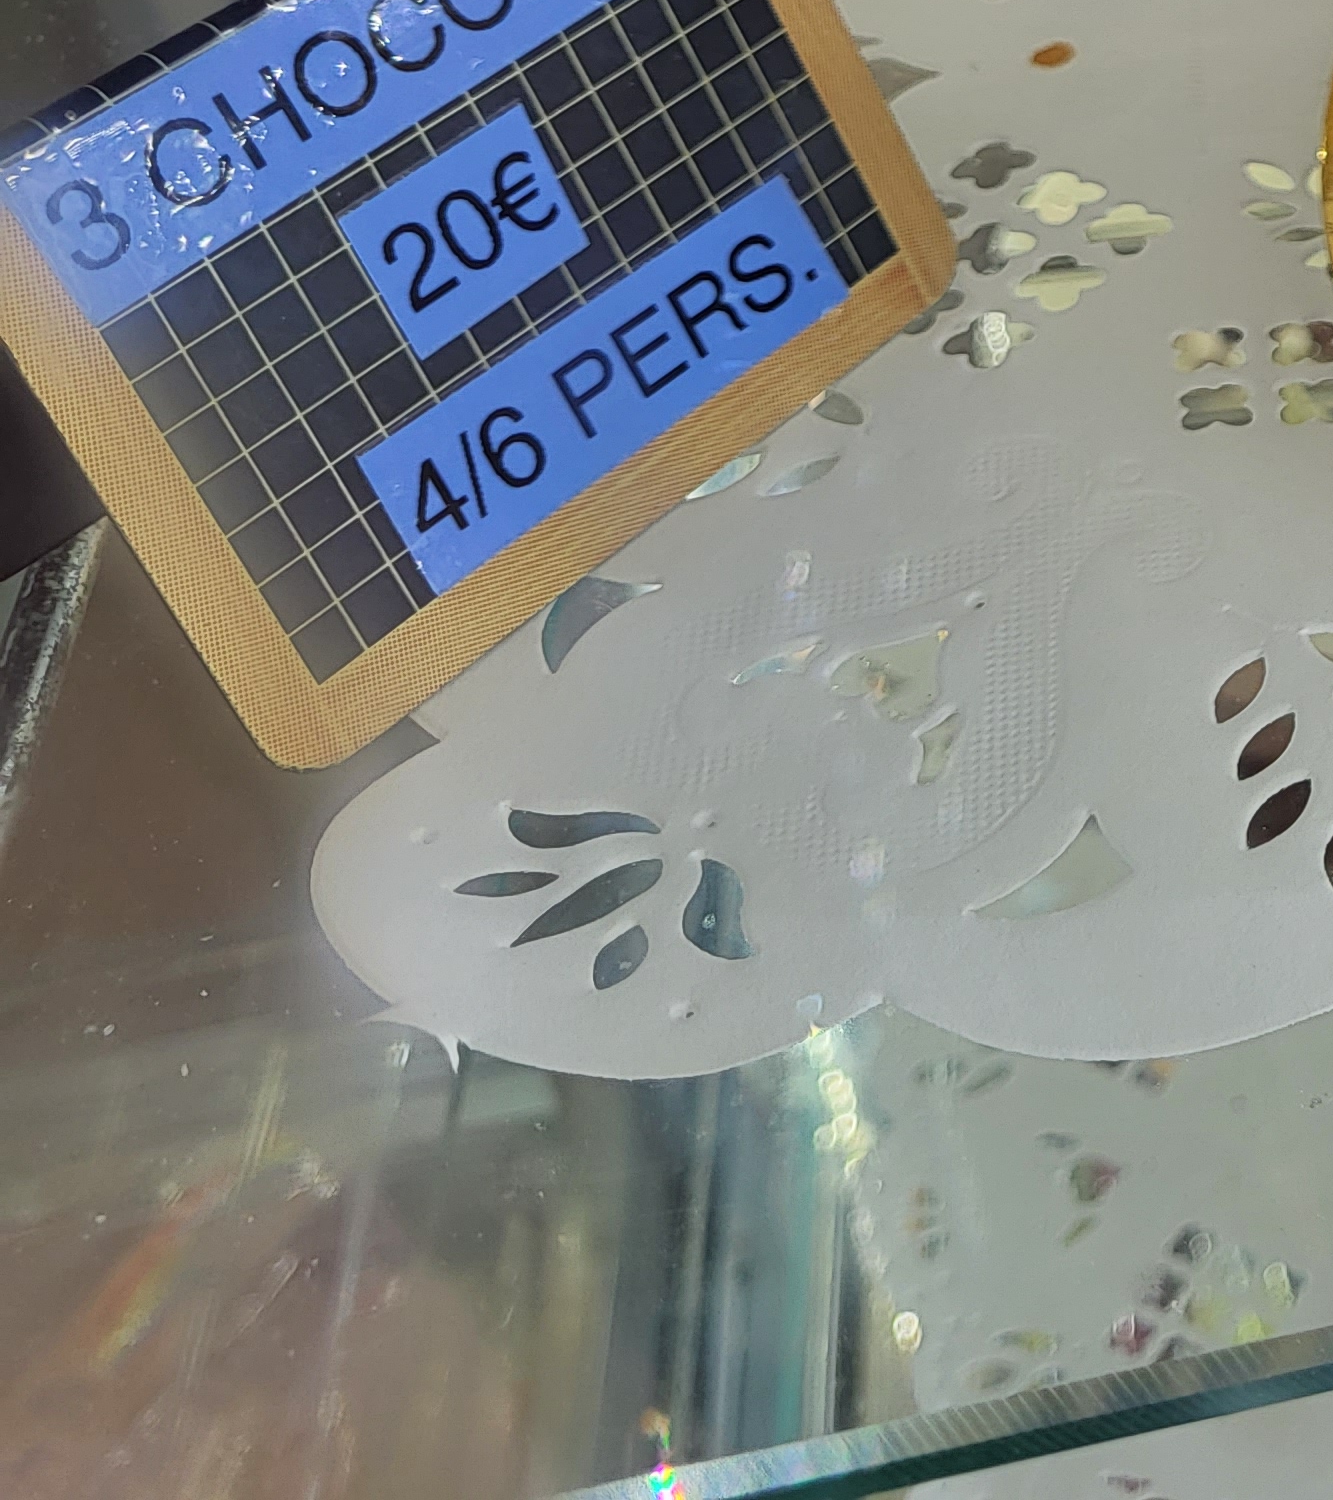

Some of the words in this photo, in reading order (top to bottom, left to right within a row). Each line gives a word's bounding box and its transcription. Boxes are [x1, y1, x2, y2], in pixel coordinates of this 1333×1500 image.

[46, 180, 130, 271] 3
[383, 152, 558, 311] 20€
[414, 407, 547, 533] 4/6
[554, 234, 817, 437] PERS.
